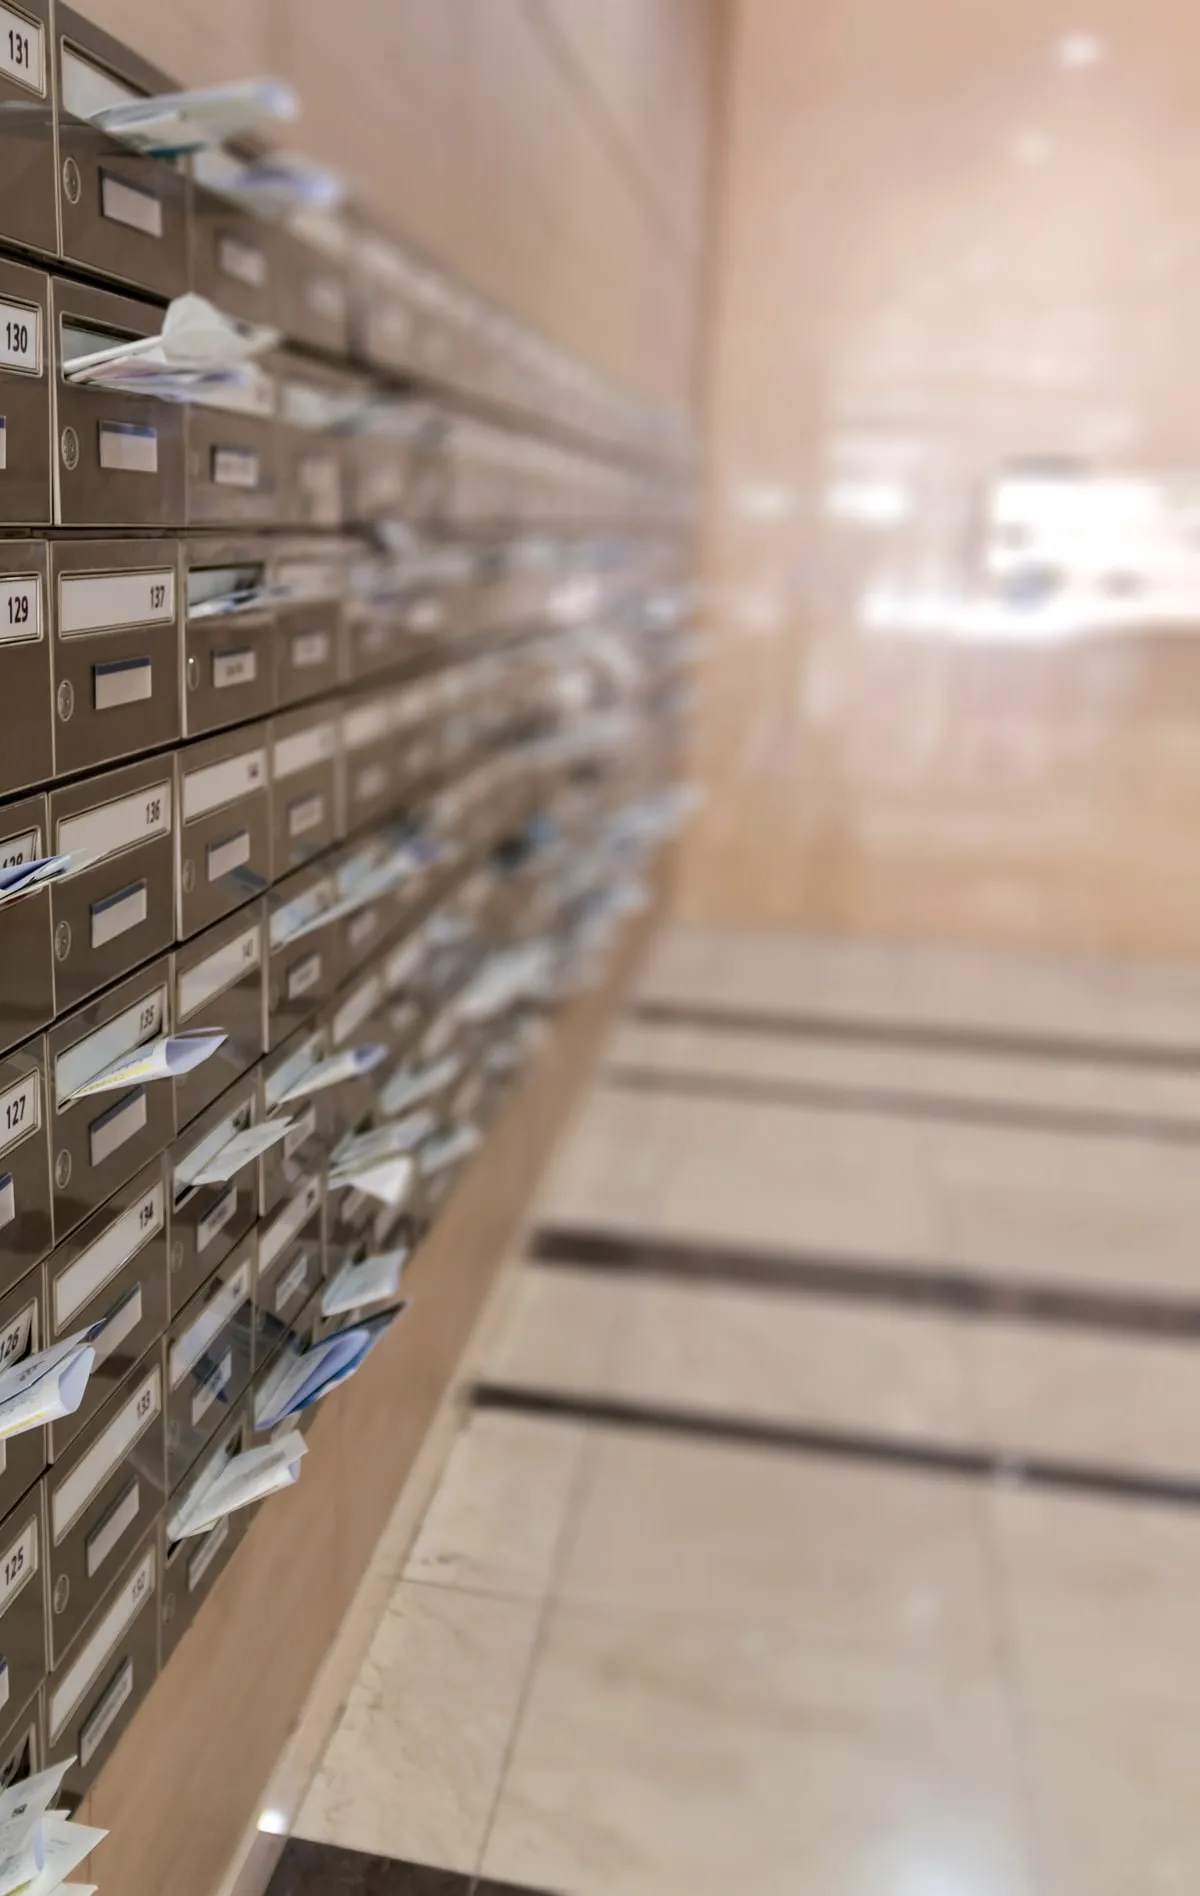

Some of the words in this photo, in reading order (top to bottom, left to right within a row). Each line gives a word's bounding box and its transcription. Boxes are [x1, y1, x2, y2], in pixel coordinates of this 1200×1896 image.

[8, 29, 29, 69] 131
[5, 321, 28, 354] 130
[7, 595, 29, 625] 129
[149, 584, 166, 609] 137
[145, 797, 161, 825] 136
[140, 1005, 155, 1032] 135
[6, 1094, 26, 1130] 127
[139, 1200, 155, 1230] 134
[0, 1326, 21, 1363] 126
[137, 1389, 151, 1420] 133
[4, 1546, 24, 1586] 125
